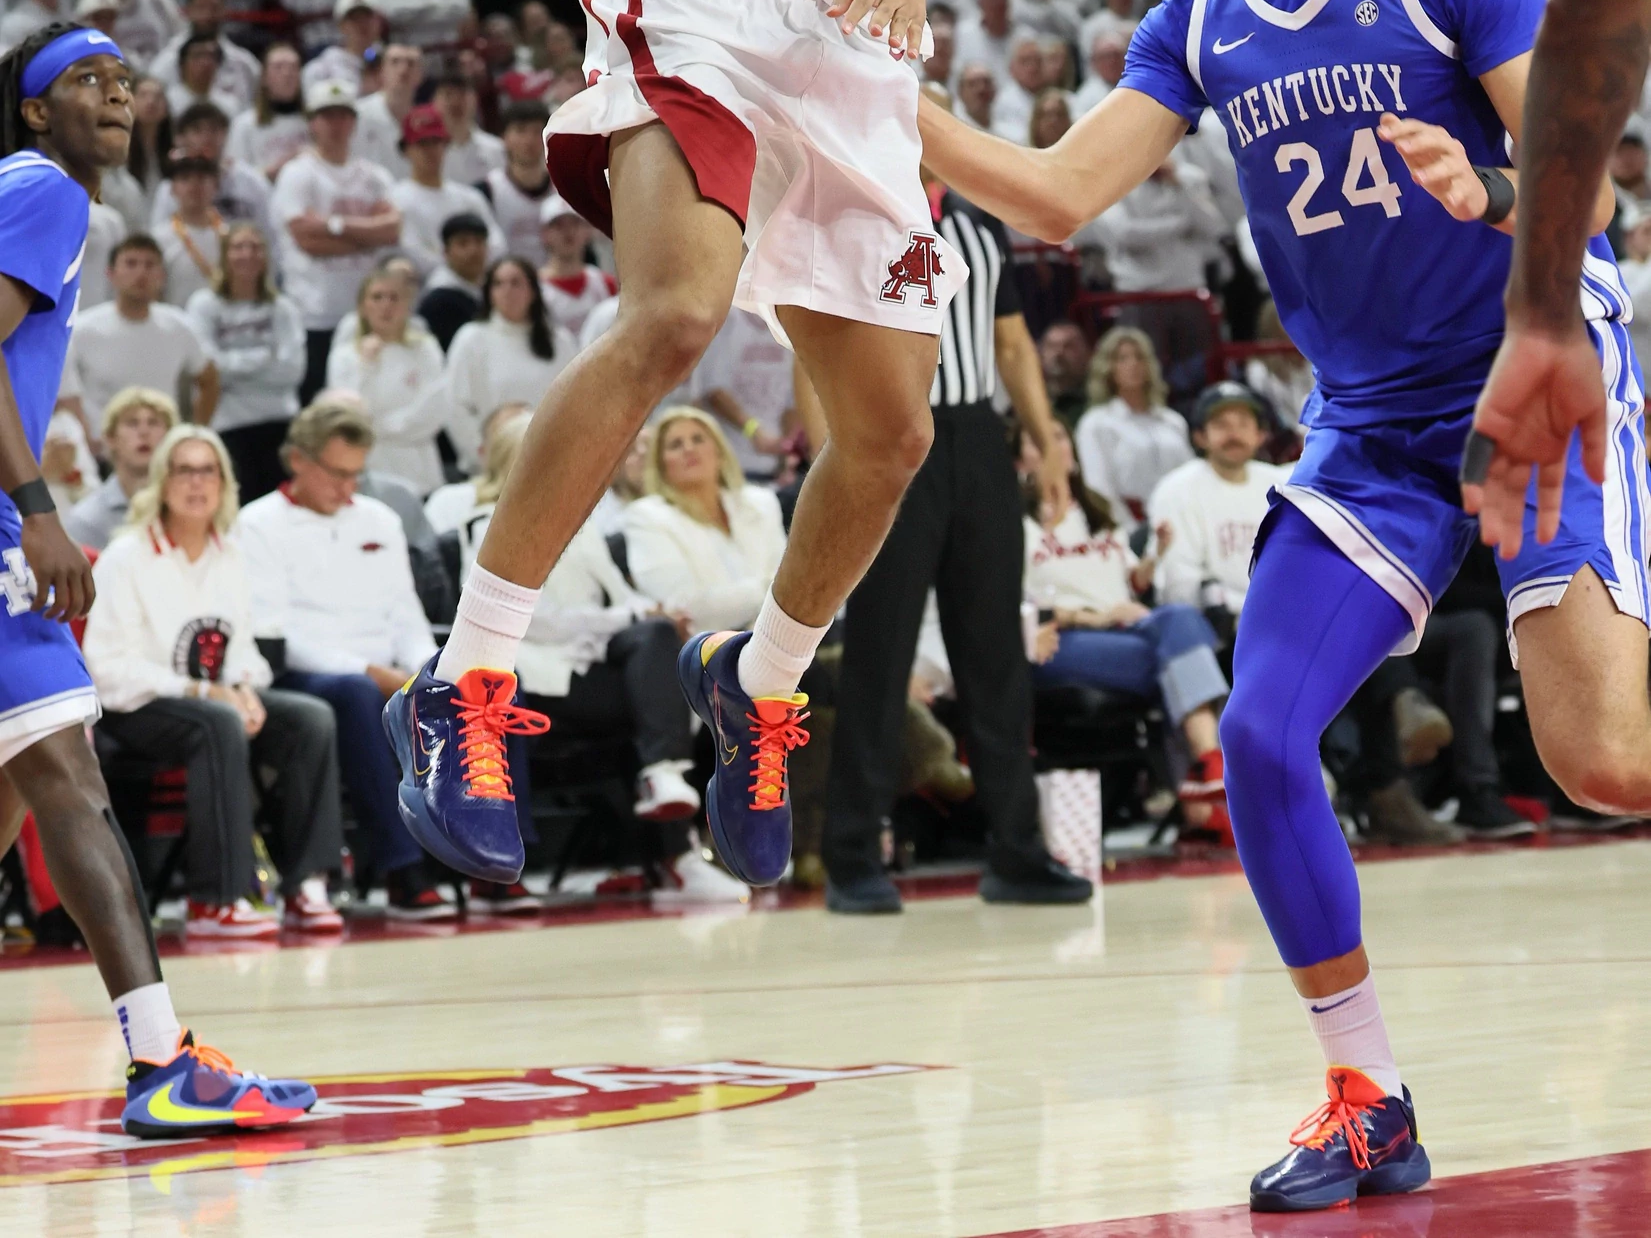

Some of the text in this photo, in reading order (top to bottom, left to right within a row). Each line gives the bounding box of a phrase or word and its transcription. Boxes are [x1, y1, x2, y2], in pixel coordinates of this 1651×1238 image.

[1356, 2, 1377, 25] SEC
[1226, 63, 1408, 149] KENTUCKY
[1274, 127, 1402, 236] 24
